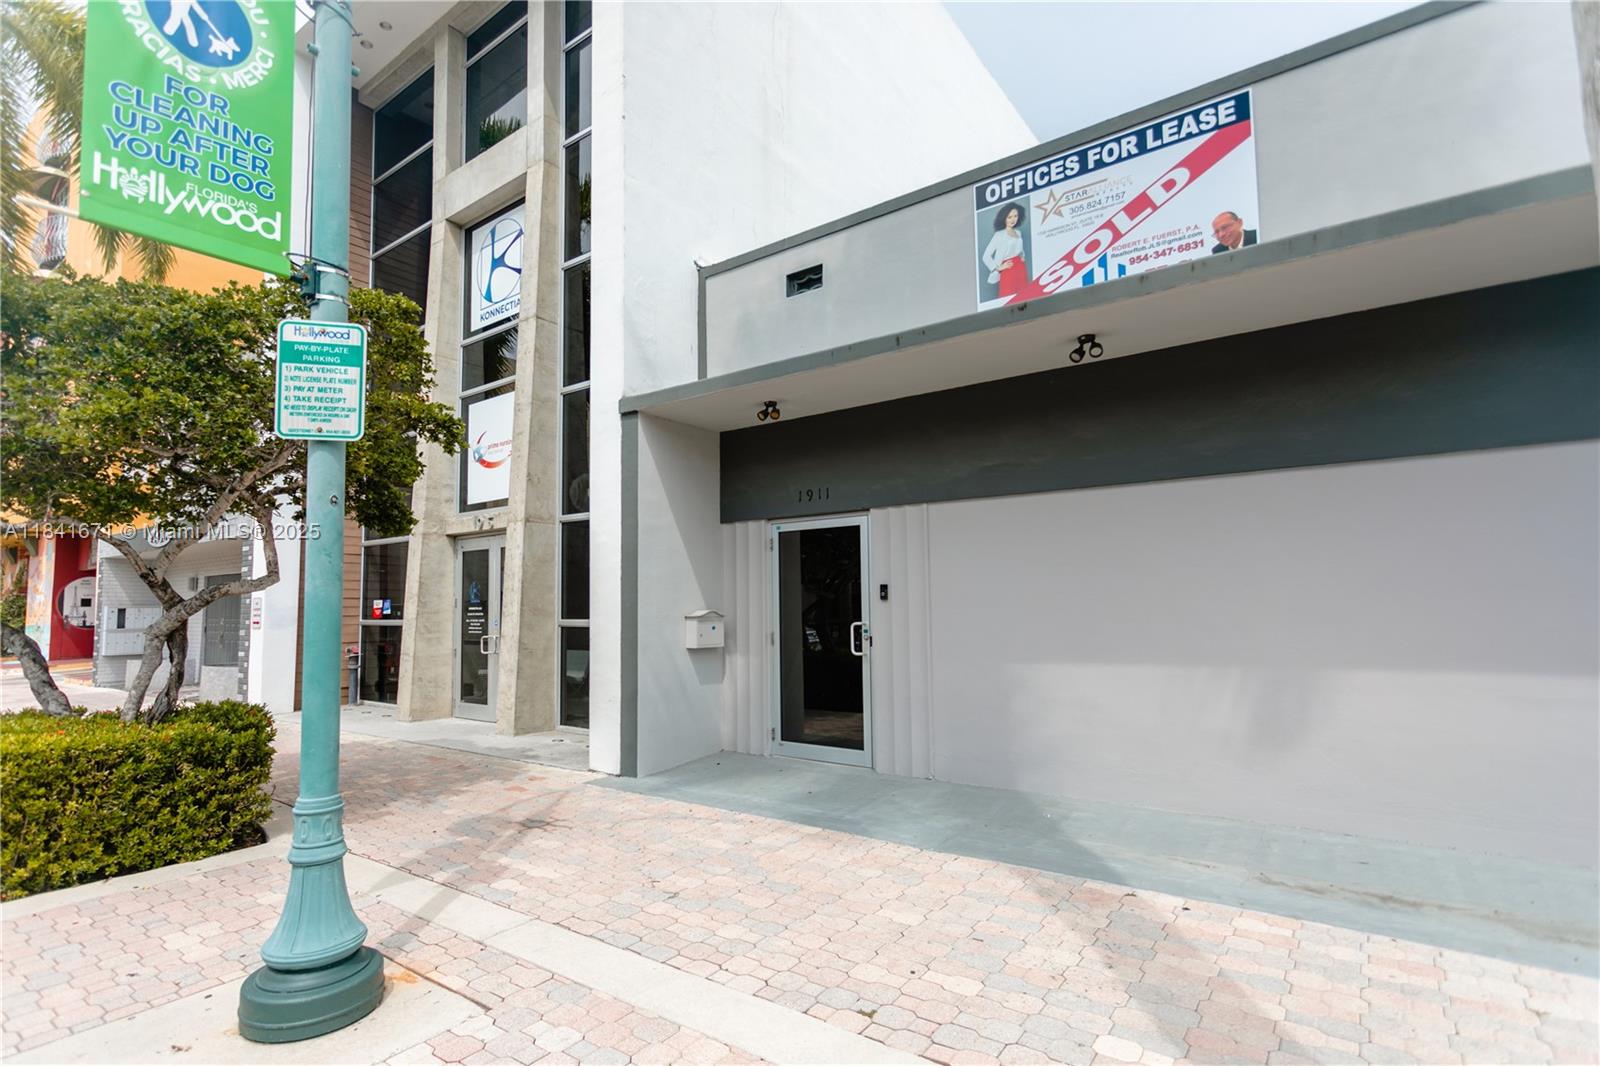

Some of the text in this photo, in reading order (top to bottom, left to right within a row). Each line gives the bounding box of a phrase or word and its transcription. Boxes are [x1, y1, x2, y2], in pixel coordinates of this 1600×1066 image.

[221, 46, 275, 89] MERCI
[165, 74, 230, 117] FOR
[109, 80, 273, 155] CLEANING
[112, 105, 270, 178] UP AFTER
[985, 99, 1237, 203] OFFICES FOR LEASE
[103, 124, 275, 200] YOUR DOG
[186, 182, 258, 214] FLORIDA'S
[1065, 189, 1088, 201] STAR
[1039, 167, 1191, 293] SOLD
[1112, 239, 1141, 253] ROBERT
[294, 344, 350, 354] PAY-BY-PLATE
[302, 355, 341, 363] PARKING
[314, 396, 347, 404] RECEIPT
[799, 487, 830, 503] 1911
